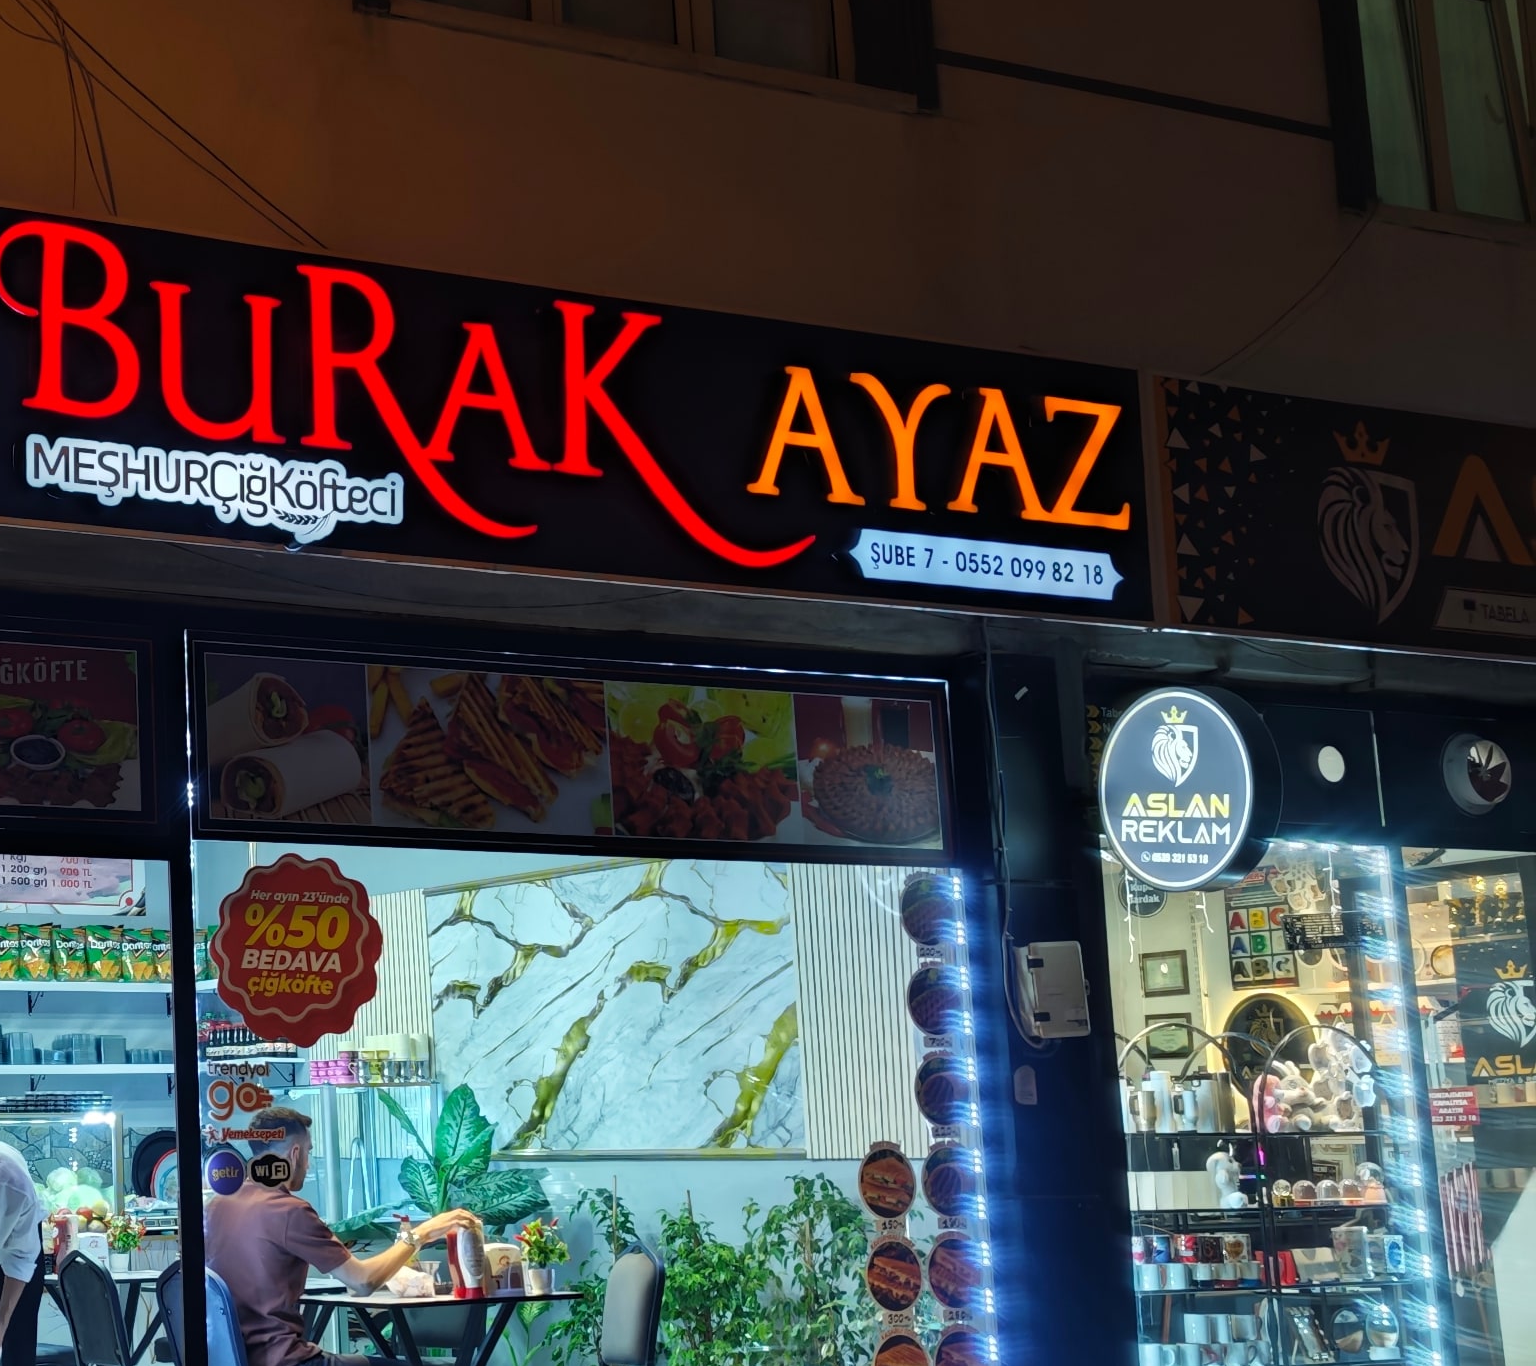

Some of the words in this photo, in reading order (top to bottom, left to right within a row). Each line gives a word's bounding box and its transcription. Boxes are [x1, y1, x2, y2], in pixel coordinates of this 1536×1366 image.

[745, 365, 1131, 531] AYAZ
[870, 541, 915, 570] ŞUBE
[923, 547, 935, 570] 7
[954, 550, 1004, 577] 0552
[1009, 554, 1046, 580] 099
[1051, 559, 1075, 584] 82
[1082, 563, 1104, 586] 18
[1480, 603, 1529, 623] TABELA
[1121, 792, 1230, 819] ASLAN
[1121, 819, 1231, 845] REKLAM
[82, 868, 93, 877] TL
[83, 880, 93, 888] TL
[250, 889, 271, 900] Her
[273, 892, 300, 904] ayın
[244, 903, 350, 950] %50
[241, 949, 342, 974] BEDAVA
[247, 971, 334, 997] çiğköfte
[208, 1060, 269, 1077] trendyol
[1472, 1055, 1536, 1078] ASL
[221, 1127, 285, 1142] Yemeksepeti
[212, 1166, 239, 1182] getir
